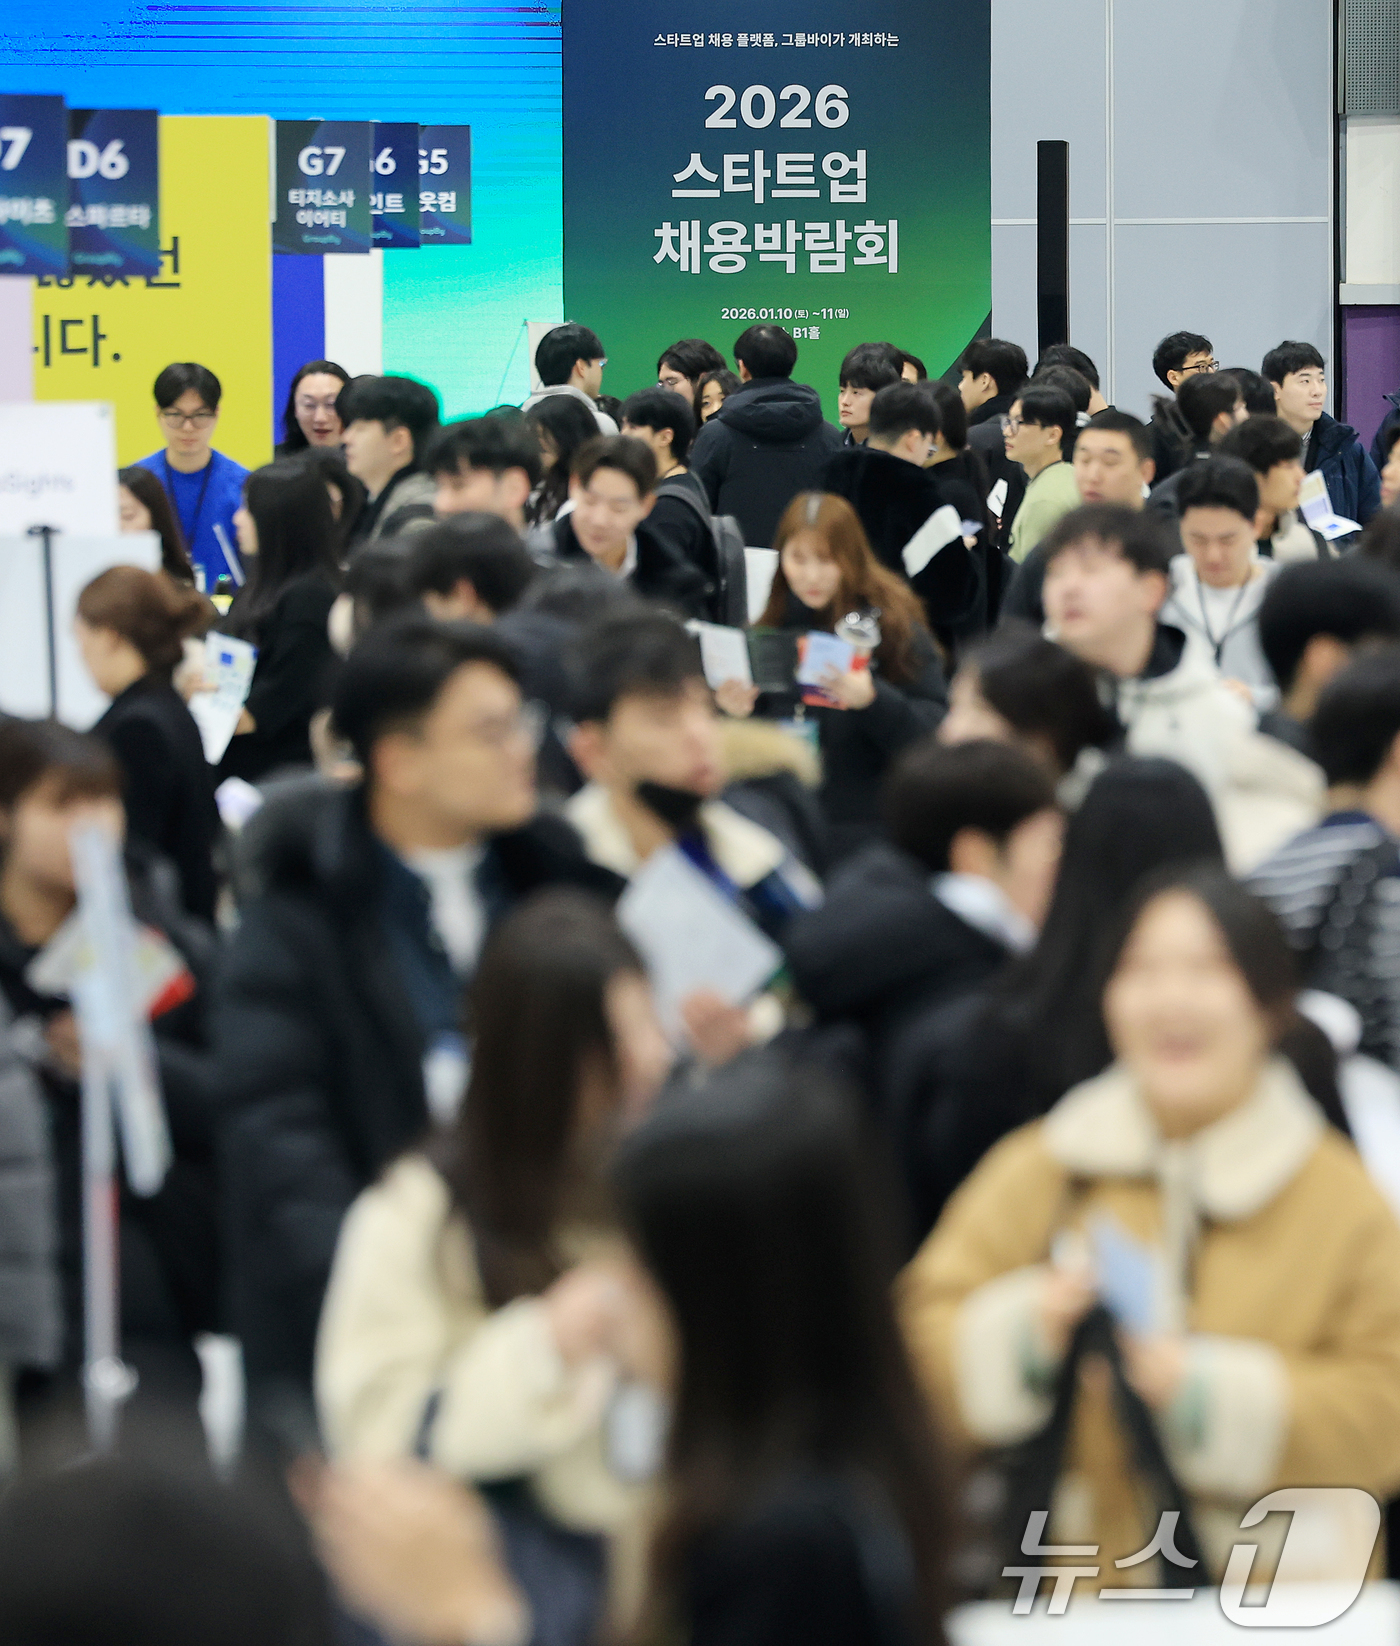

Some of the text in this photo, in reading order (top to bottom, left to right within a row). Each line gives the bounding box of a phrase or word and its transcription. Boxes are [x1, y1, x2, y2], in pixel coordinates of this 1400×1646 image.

[654, 32, 900, 49] 스타트업 채용 플랫폼, 그룹바이가 개최하는
[703, 84, 850, 129] 2026
[0, 126, 33, 171] 7
[67, 138, 129, 180] D6
[298, 146, 347, 176] G7
[369, 147, 397, 176] 6
[671, 149, 868, 204] 스타트업
[296, 209, 347, 228] 이어티
[652, 219, 899, 274] 채용박람회
[793, 326, 821, 340] B1홀
